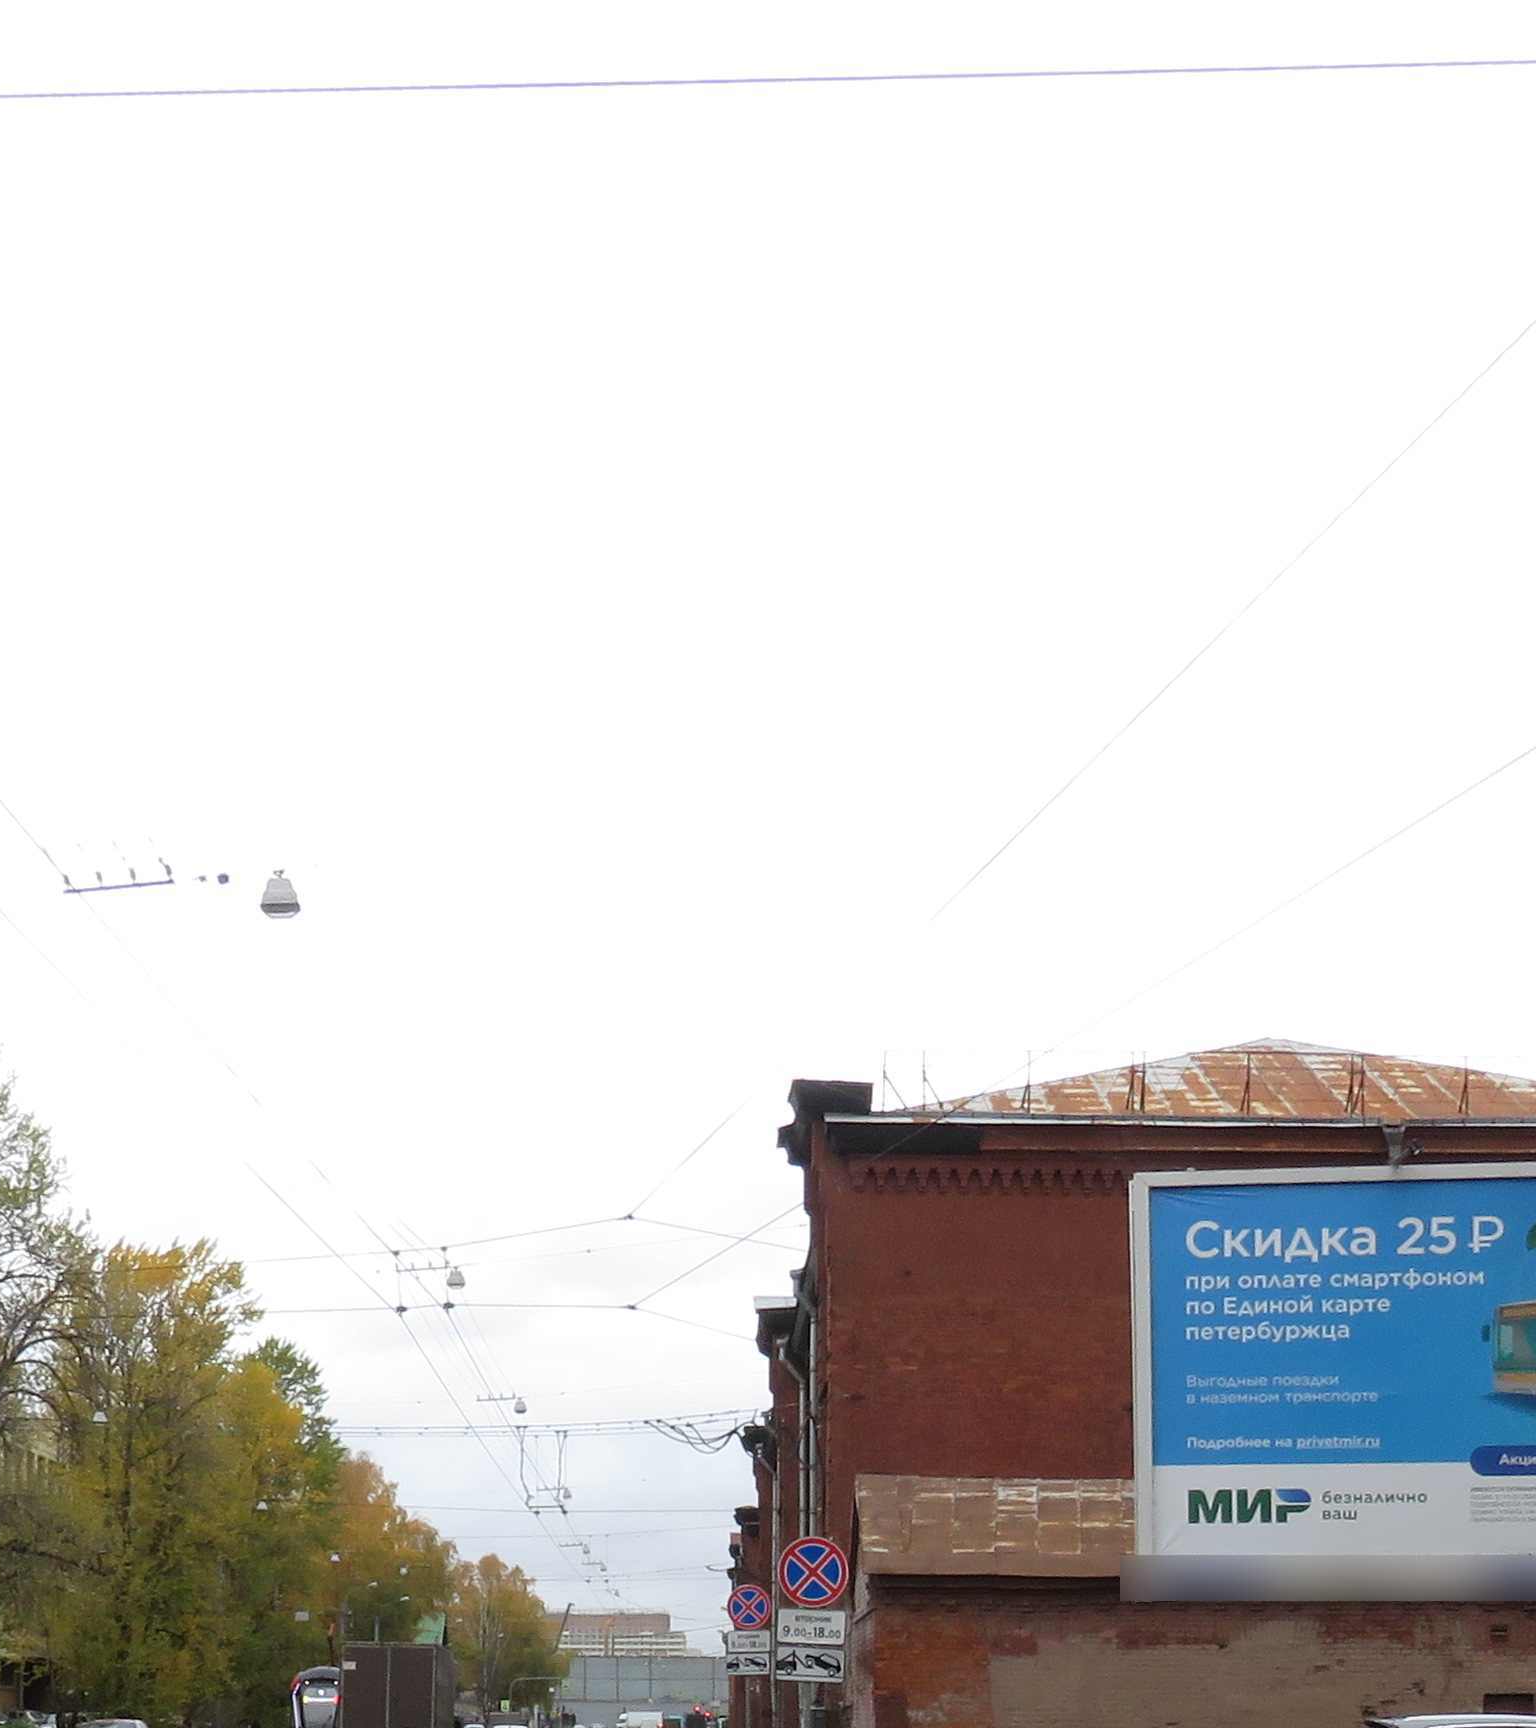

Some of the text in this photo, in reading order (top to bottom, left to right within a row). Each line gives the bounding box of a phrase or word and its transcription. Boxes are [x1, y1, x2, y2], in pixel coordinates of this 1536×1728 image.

[1185, 1219, 1377, 1264] Скидка
[1396, 1216, 1457, 1256] 25
[1185, 1267, 1485, 1292] при оплате смартфоном
[1185, 1295, 1391, 1317] по Единой карте
[1185, 1321, 1351, 1344] петербуржца
[1185, 1374, 1340, 1390] Выгодные поездки
[1201, 1392, 1280, 1404] наземном
[1285, 1390, 1379, 1405] транспорте
[1186, 1435, 1381, 1450] Подробнее на privetmir.ru
[1187, 1488, 1428, 1525] МИР безналично
[1322, 1509, 1358, 1521] ваш
